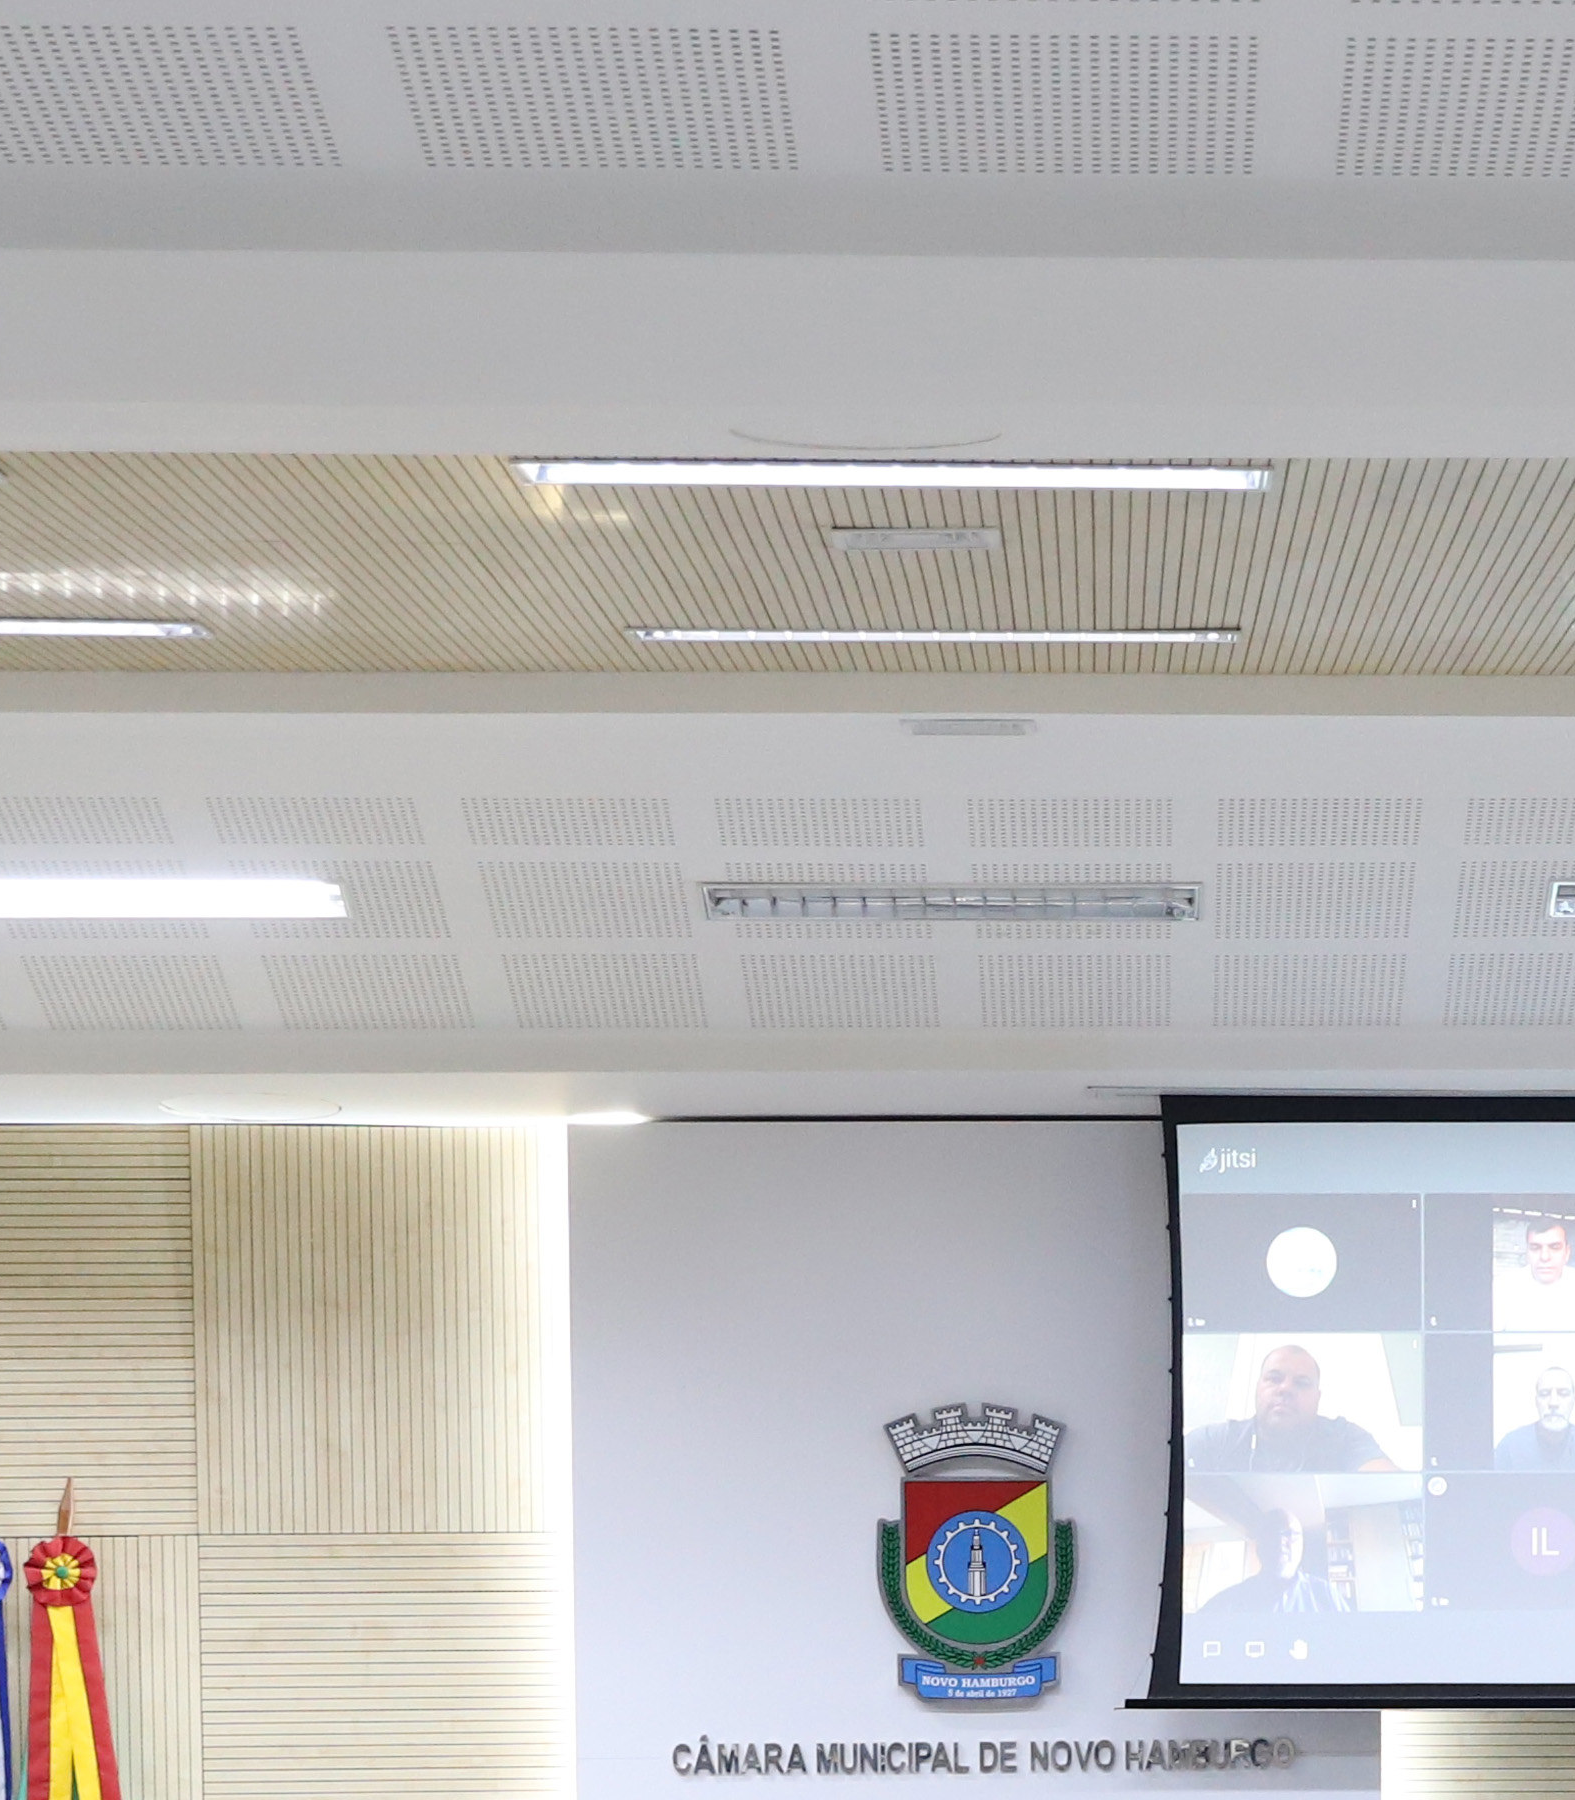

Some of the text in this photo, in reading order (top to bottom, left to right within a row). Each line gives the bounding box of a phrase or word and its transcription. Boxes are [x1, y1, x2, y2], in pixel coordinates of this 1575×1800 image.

[1218, 1147, 1256, 1173] jitsi
[1532, 1527, 1559, 1556] IL
[921, 1675, 1036, 1688] NOVO HAMBURGO
[997, 1688, 1017, 1697] 1927
[672, 1735, 1296, 1775] CÂMARA MUNICIPAL DE NOVO HAMBURGO
